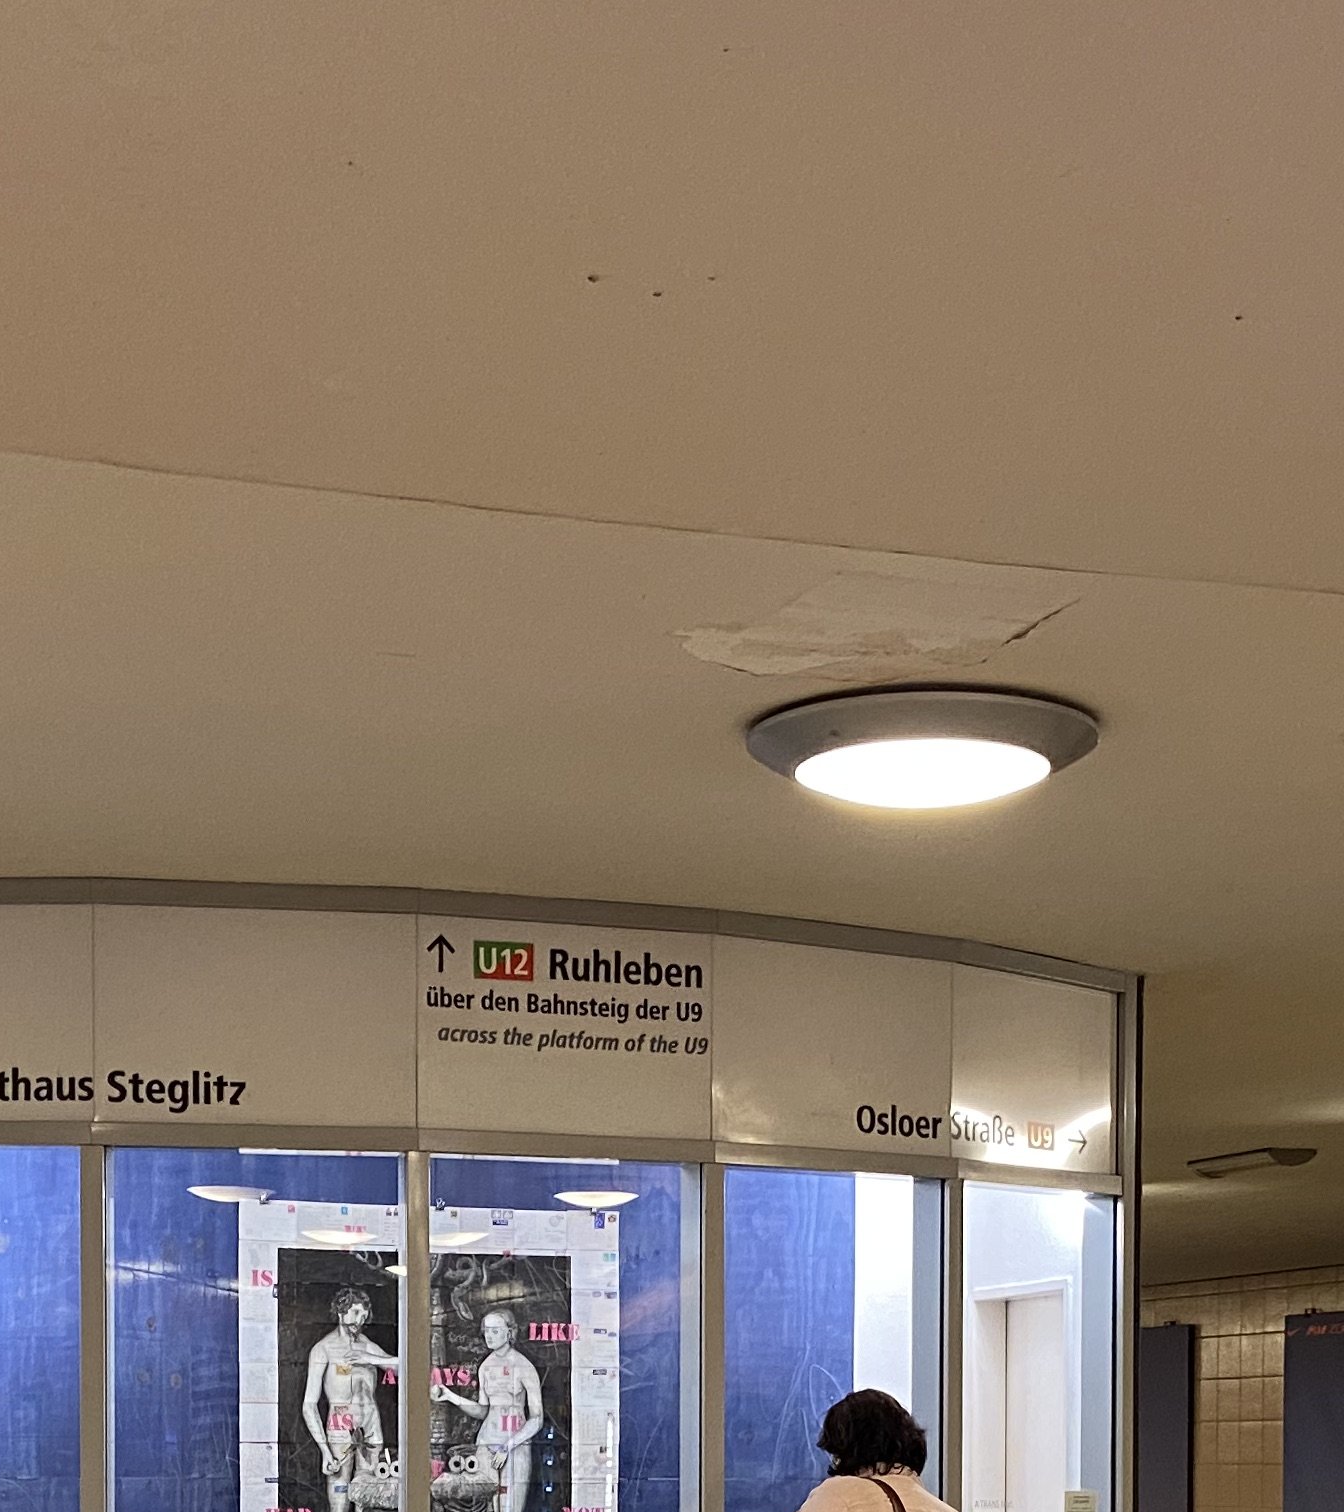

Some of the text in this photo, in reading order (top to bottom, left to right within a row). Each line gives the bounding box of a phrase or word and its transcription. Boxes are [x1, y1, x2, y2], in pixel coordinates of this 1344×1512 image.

[479, 947, 703, 989] U12 Ruhleben
[426, 986, 703, 1023] über den Bahnsteig der U9
[438, 1026, 708, 1055] across the platform of the U9
[107, 1069, 247, 1114] Steglitz
[856, 1104, 1053, 1148] Osloer Straße U9
[251, 1269, 273, 1287] IS
[528, 1322, 581, 1341] LIKE
